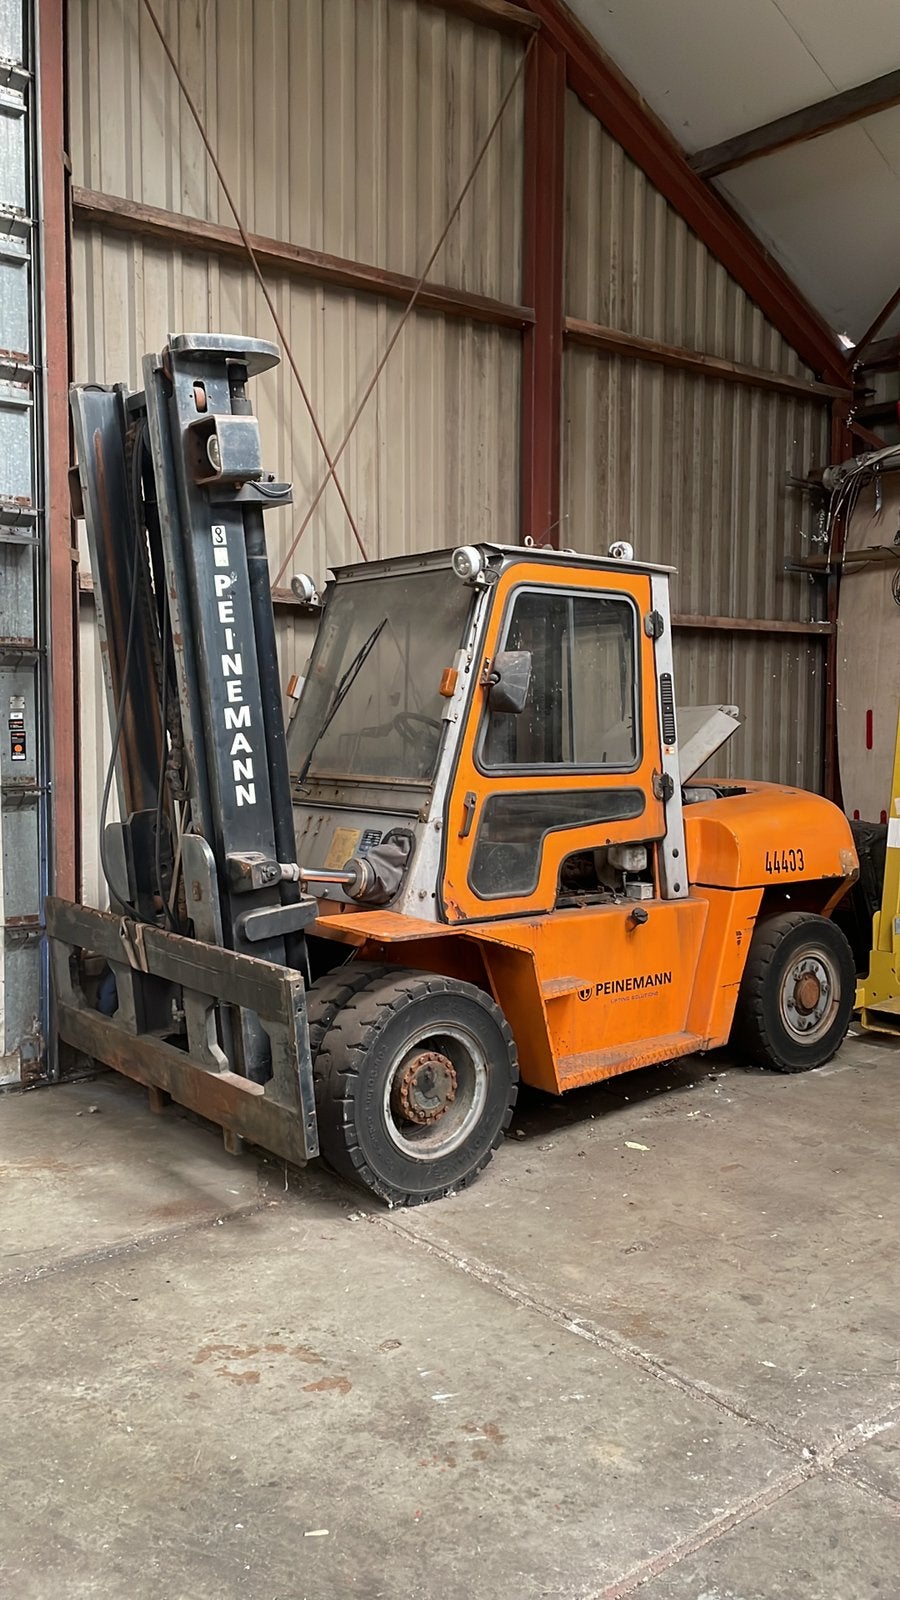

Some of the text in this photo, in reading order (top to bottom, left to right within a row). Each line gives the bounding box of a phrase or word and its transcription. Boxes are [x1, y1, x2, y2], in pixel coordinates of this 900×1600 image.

[214, 574, 256, 807] PEINEMANN
[765, 849, 804, 874] 44403
[595, 971, 672, 996] PEINEMANN
